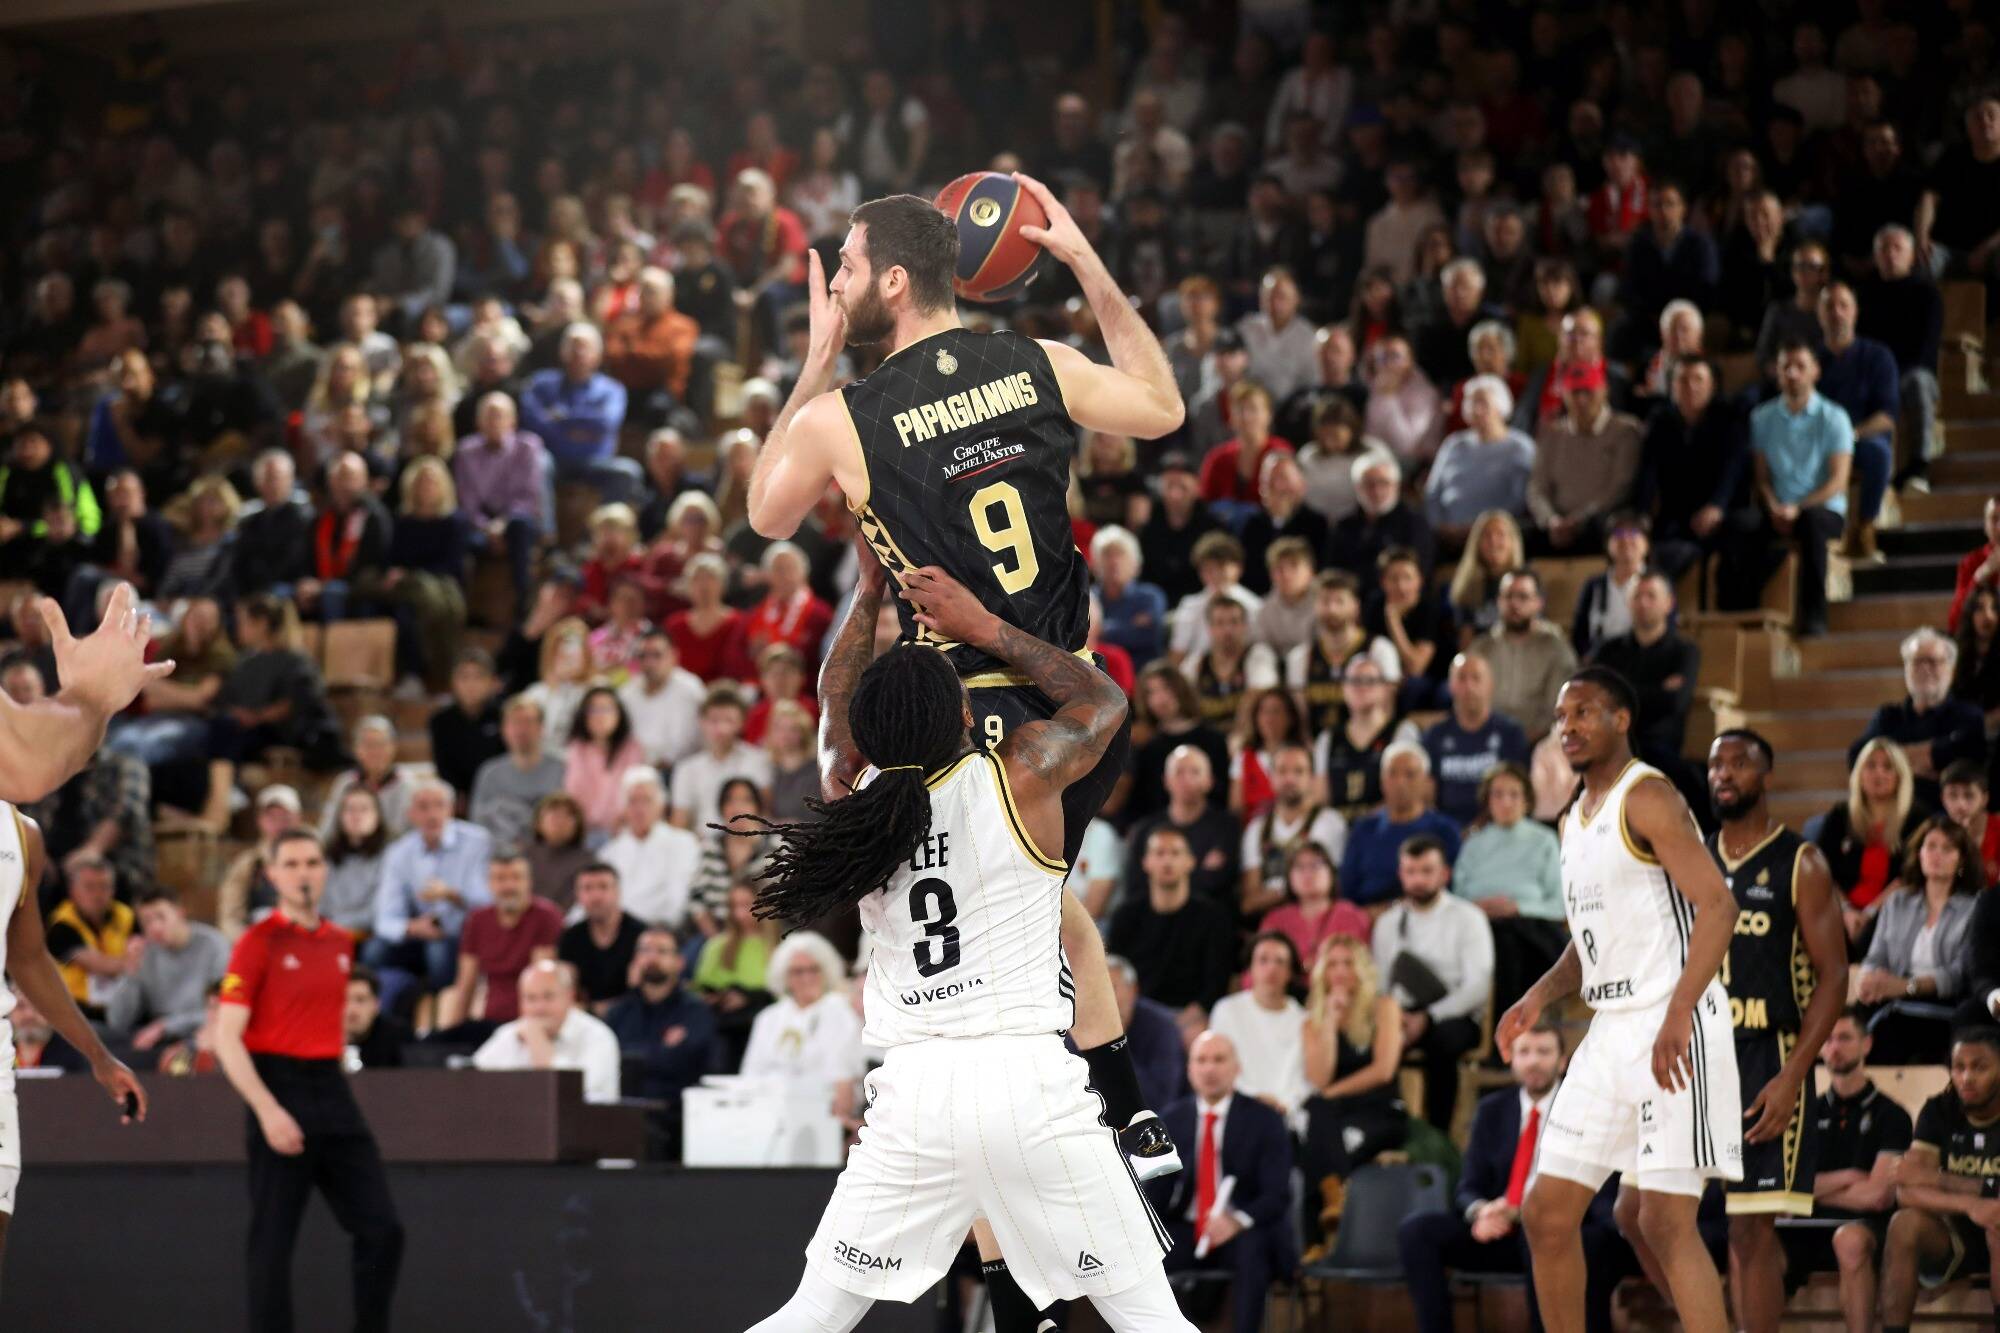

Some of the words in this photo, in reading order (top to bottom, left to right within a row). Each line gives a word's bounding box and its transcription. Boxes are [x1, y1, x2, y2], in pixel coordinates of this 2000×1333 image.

[892, 371, 1038, 448] PAPAGIANNIS
[942, 457, 983, 479] MICHEL
[983, 443, 1026, 463] PASTOR
[953, 436, 1001, 461] GROUPE
[968, 480, 1040, 595] 9
[984, 714, 1004, 750] 9
[910, 831, 949, 871] LEE
[908, 877, 961, 979] 3
[1582, 928, 1599, 967] 8
[833, 1256, 867, 1275] assurances
[834, 1239, 903, 1271] REPAM
